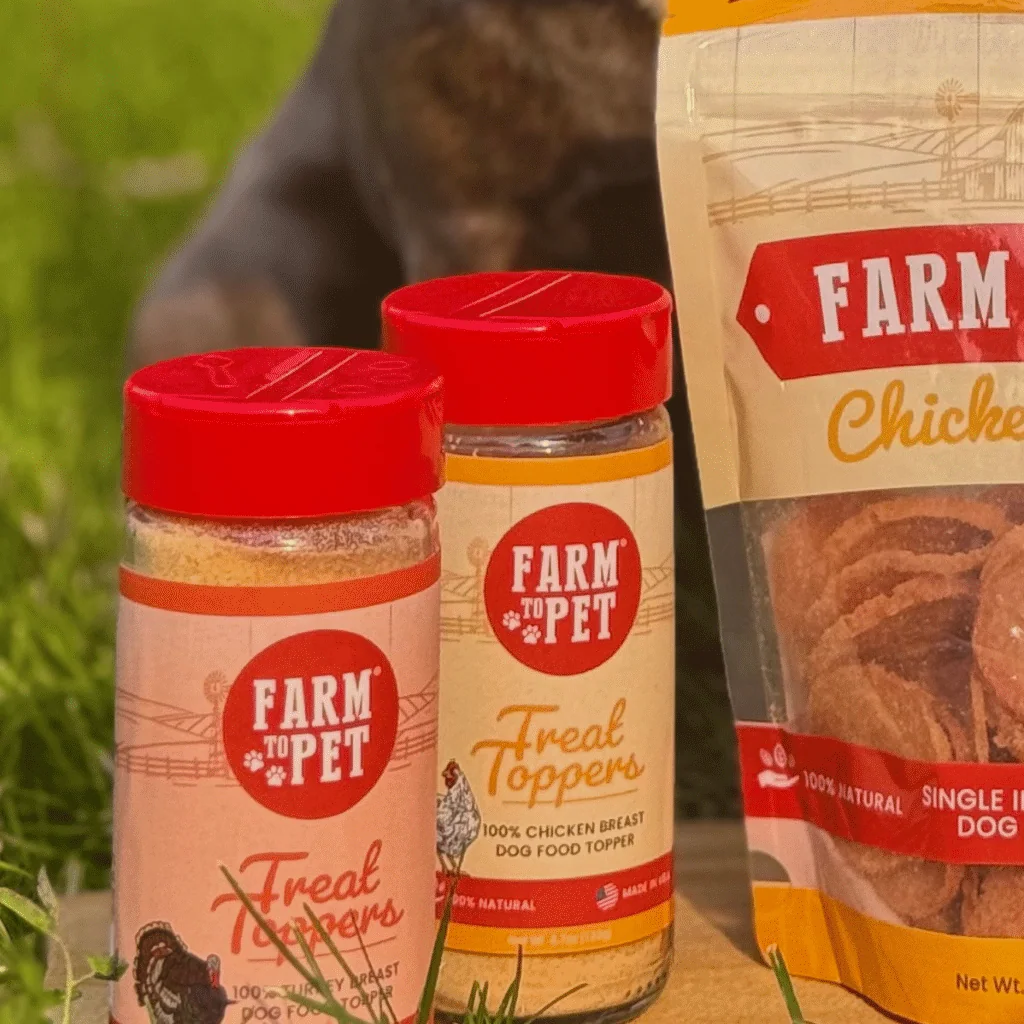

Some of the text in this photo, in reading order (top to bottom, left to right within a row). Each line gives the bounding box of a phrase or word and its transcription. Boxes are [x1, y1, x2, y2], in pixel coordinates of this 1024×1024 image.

[813, 250, 1010, 345] FARM
[511, 538, 620, 593] FARM
[521, 591, 617, 645] TO PET
[252, 667, 373, 731] FARM
[263, 724, 370, 786] TO PET
[496, 697, 627, 762] Treat
[470, 739, 646, 809] Toppers
[803, 770, 903, 815] 100% NATURAL
[921, 784, 1004, 812] SINGLE
[483, 810, 645, 839] 100% CHICKEN BREAST
[495, 833, 635, 858] DOG FOOD TOPPER
[957, 815, 1018, 839] DOG
[239, 838, 382, 915] Treat
[210, 893, 405, 967] Toppers
[478, 897, 537, 912] NATURAL
[955, 972, 989, 992] Net
[993, 975, 1024, 995] Wt.
[242, 1005, 282, 1022] DOG
